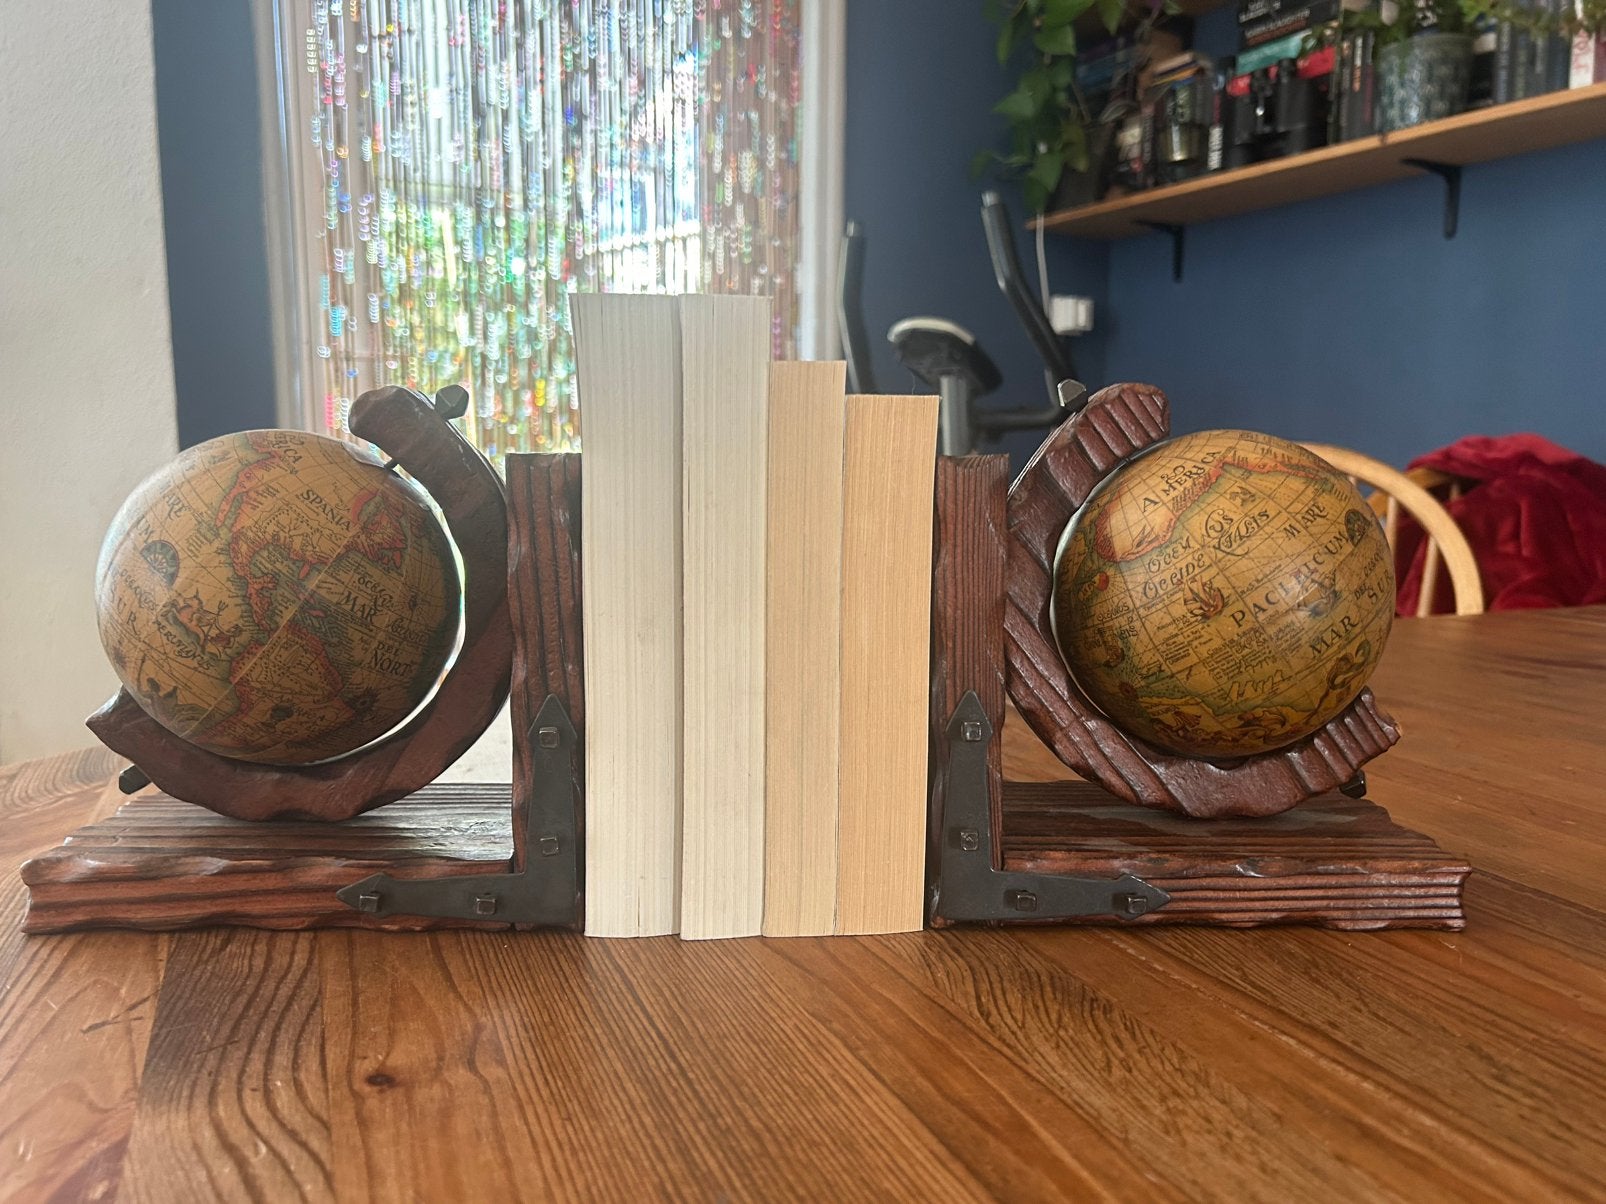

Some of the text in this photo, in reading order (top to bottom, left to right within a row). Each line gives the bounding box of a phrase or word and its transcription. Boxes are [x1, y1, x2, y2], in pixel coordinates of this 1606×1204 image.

[1143, 451, 1221, 513] AMERICA
[301, 489, 351, 531] SPANIA
[1283, 501, 1328, 541] MARE
[1309, 615, 1360, 661] MAR
